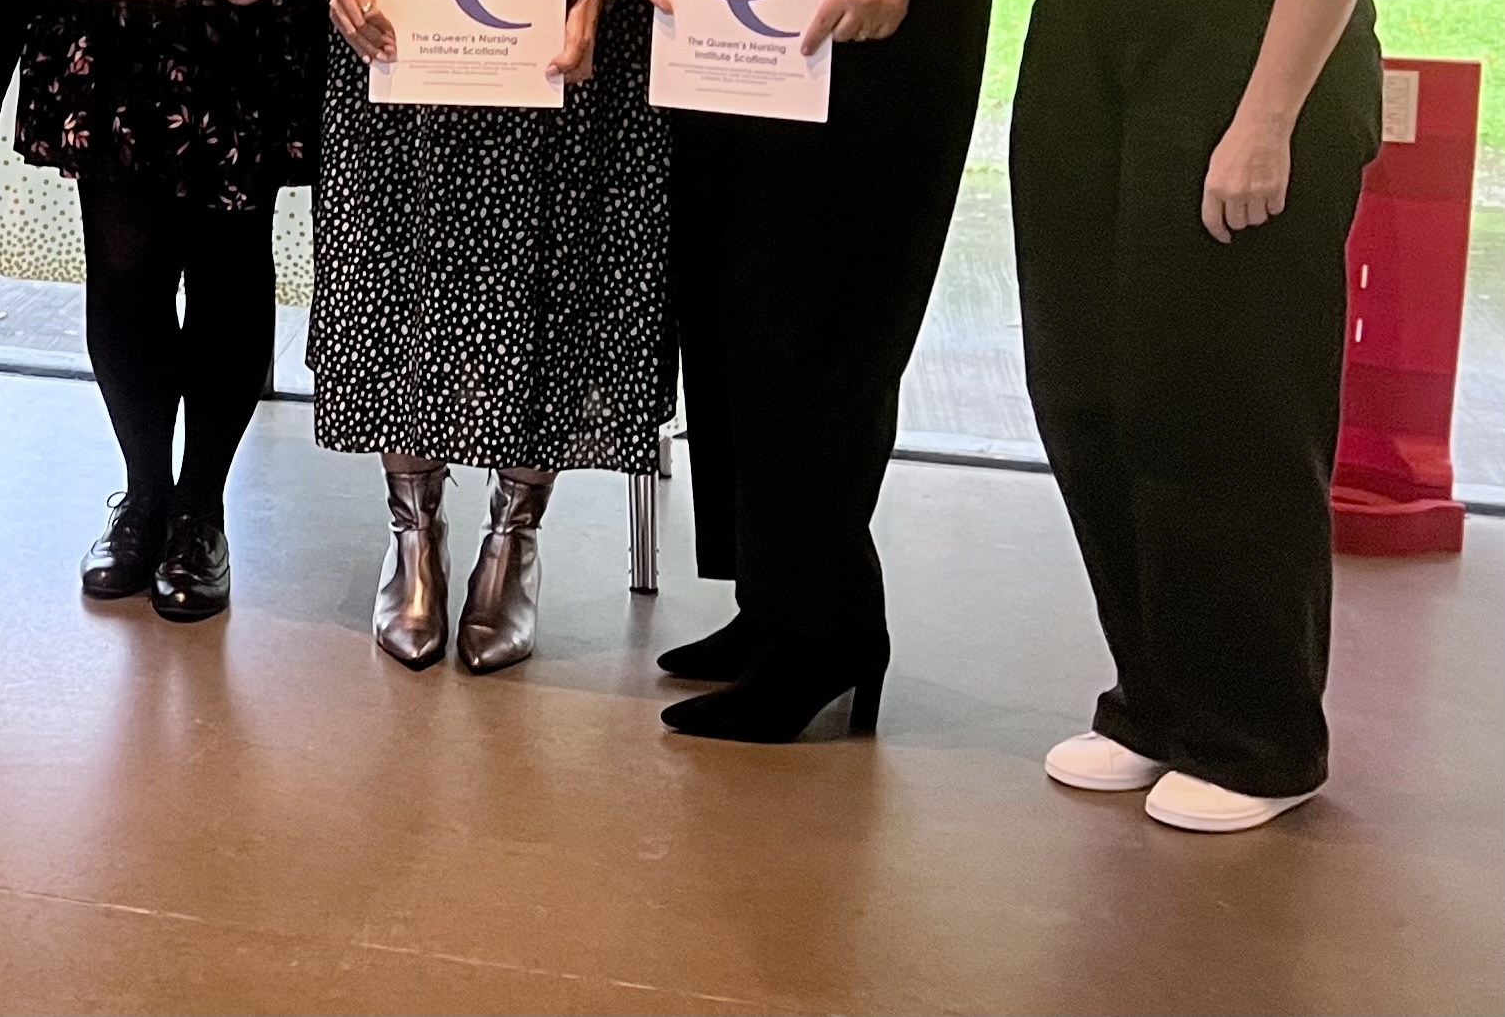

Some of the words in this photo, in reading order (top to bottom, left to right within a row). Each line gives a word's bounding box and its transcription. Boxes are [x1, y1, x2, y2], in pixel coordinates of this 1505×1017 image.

[411, 33, 428, 42] The
[432, 33, 475, 42] Queen's
[479, 35, 517, 45] Nursing
[420, 45, 459, 54] Institute
[463, 47, 508, 56] Scotland
[688, 37, 703, 46] The
[706, 38, 746, 50] Queen's
[749, 42, 786, 55] Nursing
[695, 51, 730, 61] Institute
[734, 54, 777, 65] Scotland
